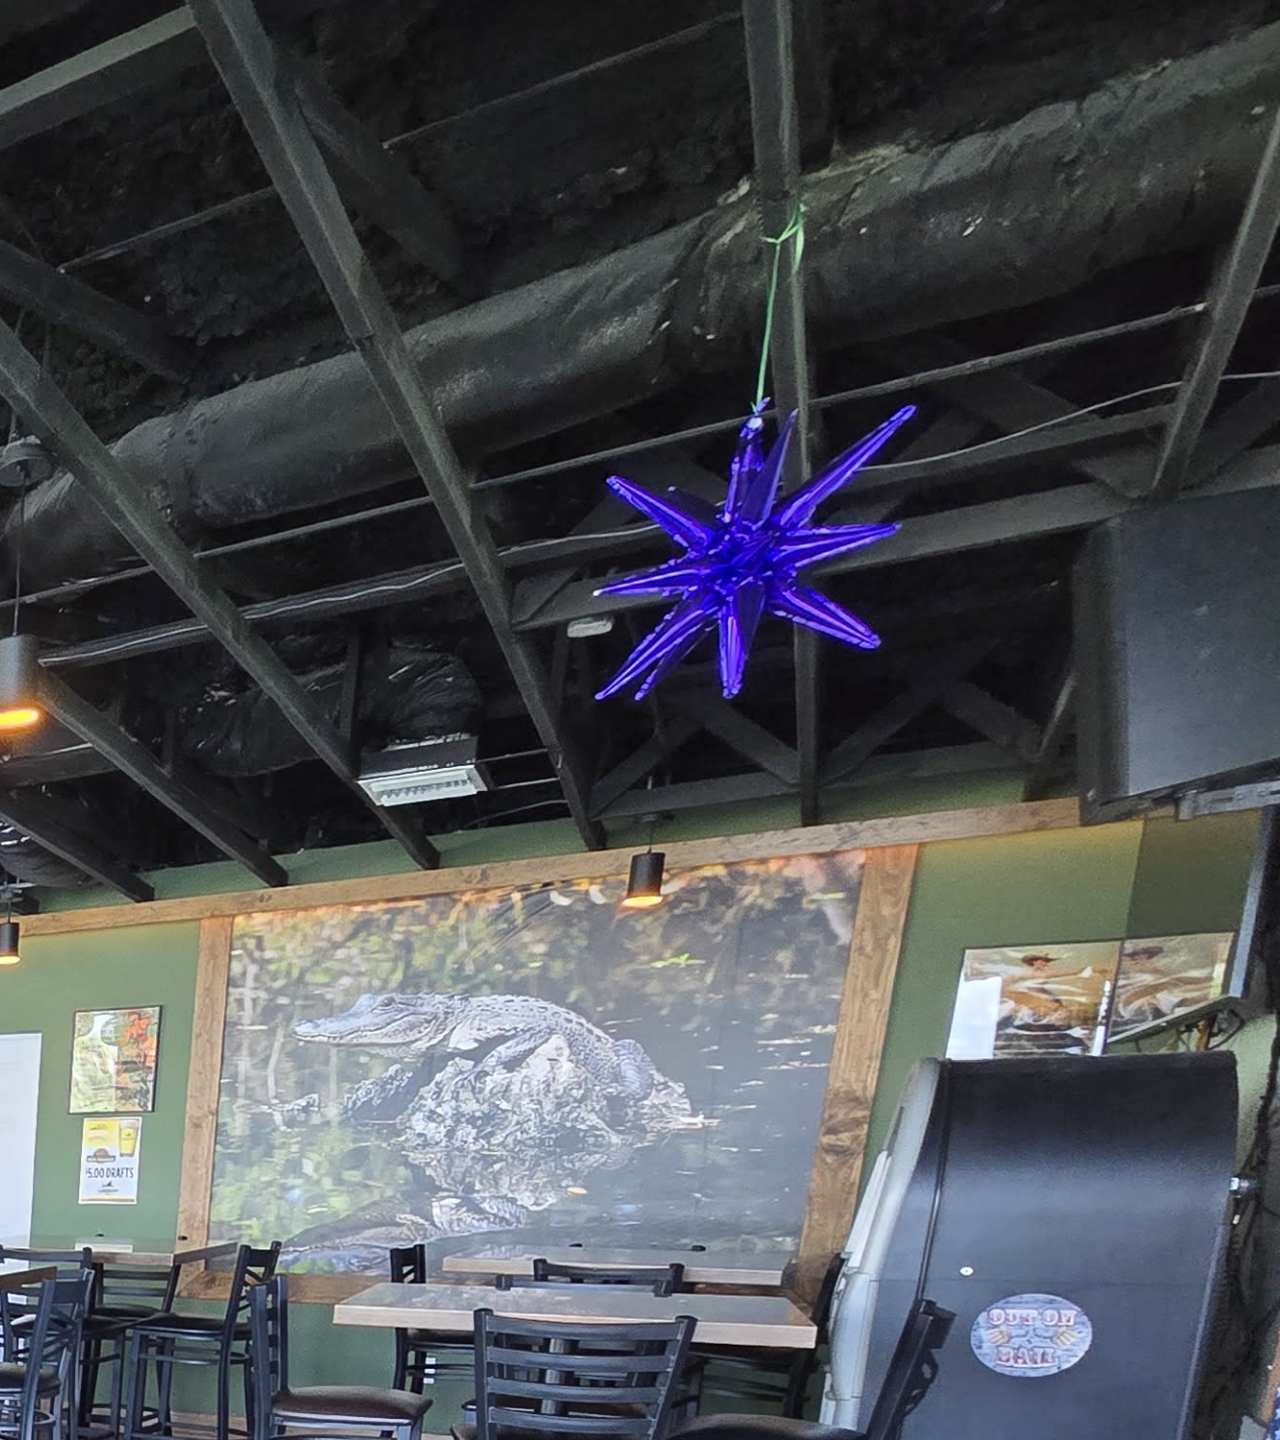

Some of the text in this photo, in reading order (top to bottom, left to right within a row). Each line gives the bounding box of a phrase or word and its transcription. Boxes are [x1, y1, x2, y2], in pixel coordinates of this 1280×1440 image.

[105, 1167, 134, 1178] DRAFTS
[988, 1309, 1078, 1326] OUT ON
